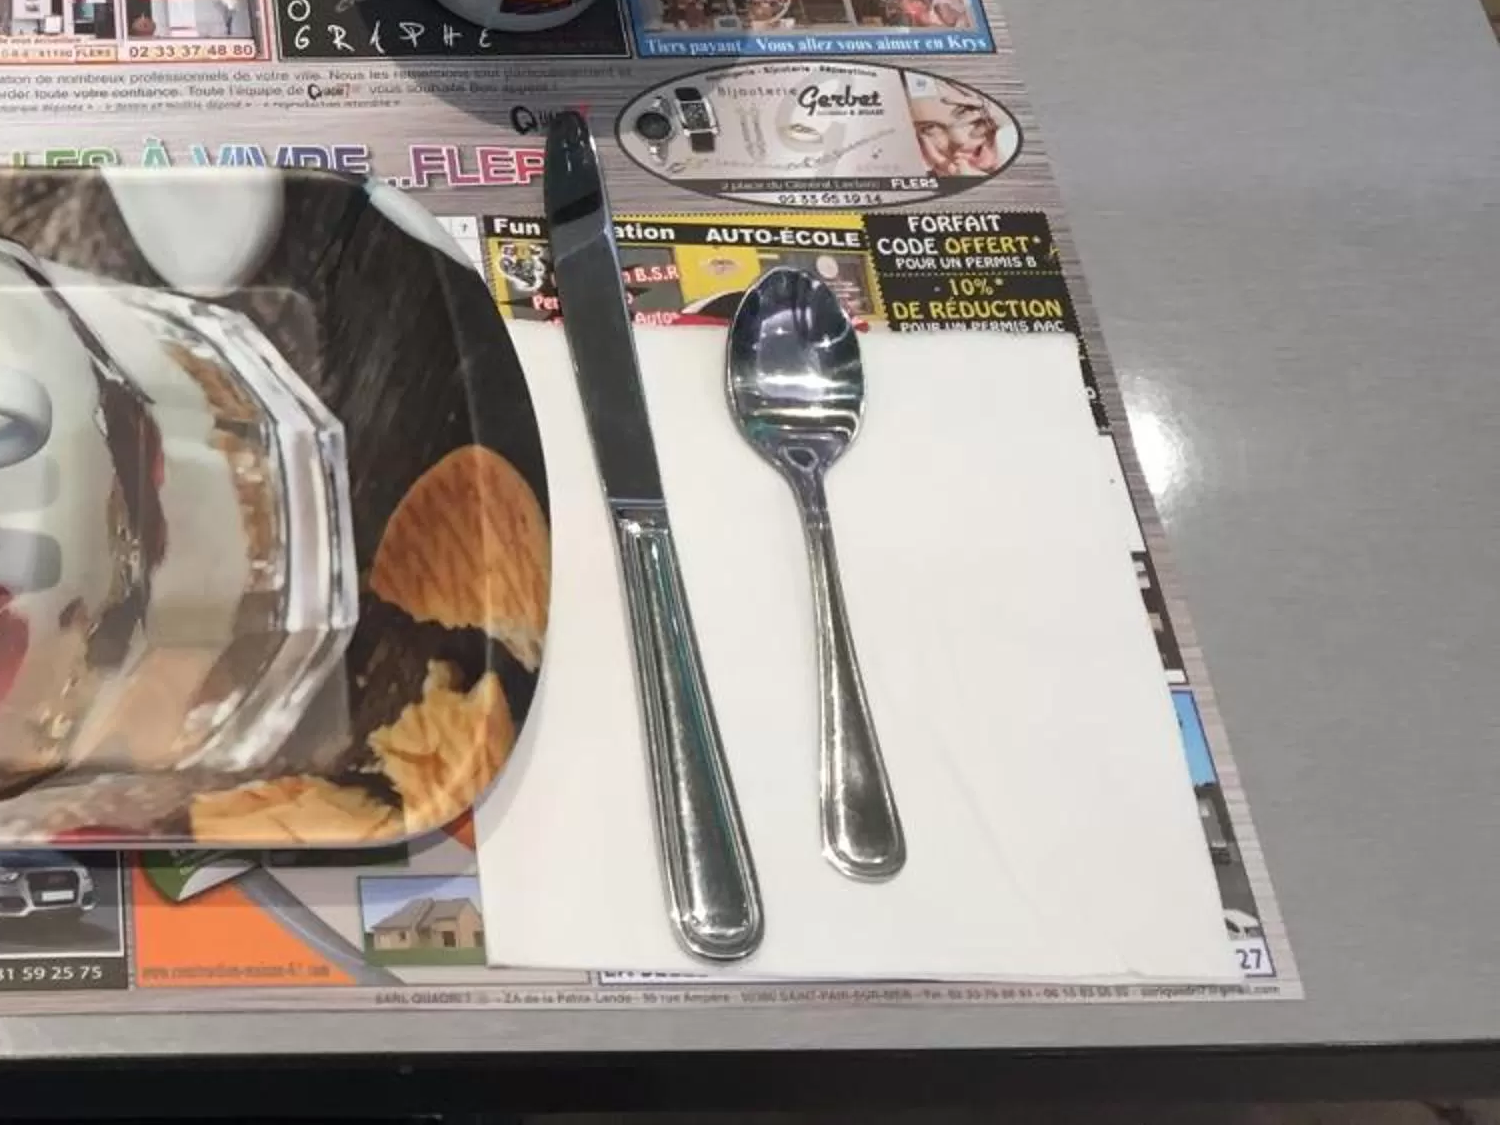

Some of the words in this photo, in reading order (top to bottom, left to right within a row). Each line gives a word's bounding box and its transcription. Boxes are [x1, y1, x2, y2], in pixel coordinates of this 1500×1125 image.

[129, 46, 149, 58] 02
[155, 45, 175, 58] 33
[181, 45, 202, 57] 37
[207, 44, 227, 56] 48
[232, 44, 253, 56] 80
[646, 37, 687, 53] Tiers
[689, 39, 743, 57] payant
[755, 36, 794, 52] Vous
[797, 35, 832, 52] allez
[837, 37, 874, 51] vous
[876, 35, 921, 51] aimer
[925, 37, 945, 51] en
[947, 34, 990, 54] Krys
[36, 73, 54, 84] de
[57, 72, 126, 84] nombreux
[129, 71, 229, 85] professionnels
[234, 70, 253, 82] de
[256, 71, 289, 82] votre
[329, 69, 366, 81] Nous
[370, 69, 389, 80] les
[34, 88, 69, 100] toute
[73, 89, 108, 99] votre
[188, 86, 226, 97] Toute
[288, 85, 305, 96] de
[797, 84, 883, 117] Gerbet
[891, 177, 940, 190] FLERS
[907, 214, 1002, 233] FORFAIT
[493, 218, 542, 237] Fun
[705, 223, 861, 249] AUTO-ÉCOLE
[876, 236, 938, 256] CODE
[895, 256, 937, 271] POUR
[941, 256, 963, 270] UN
[967, 255, 1024, 270] PERMIS
[1026, 255, 1039, 269] B
[891, 301, 925, 321] DE
[929, 295, 1064, 320] RÉDUCTION
[1236, 949, 1264, 971] 27
[22, 966, 47, 981] 59
[51, 965, 76, 980] 25
[80, 965, 104, 980] 75
